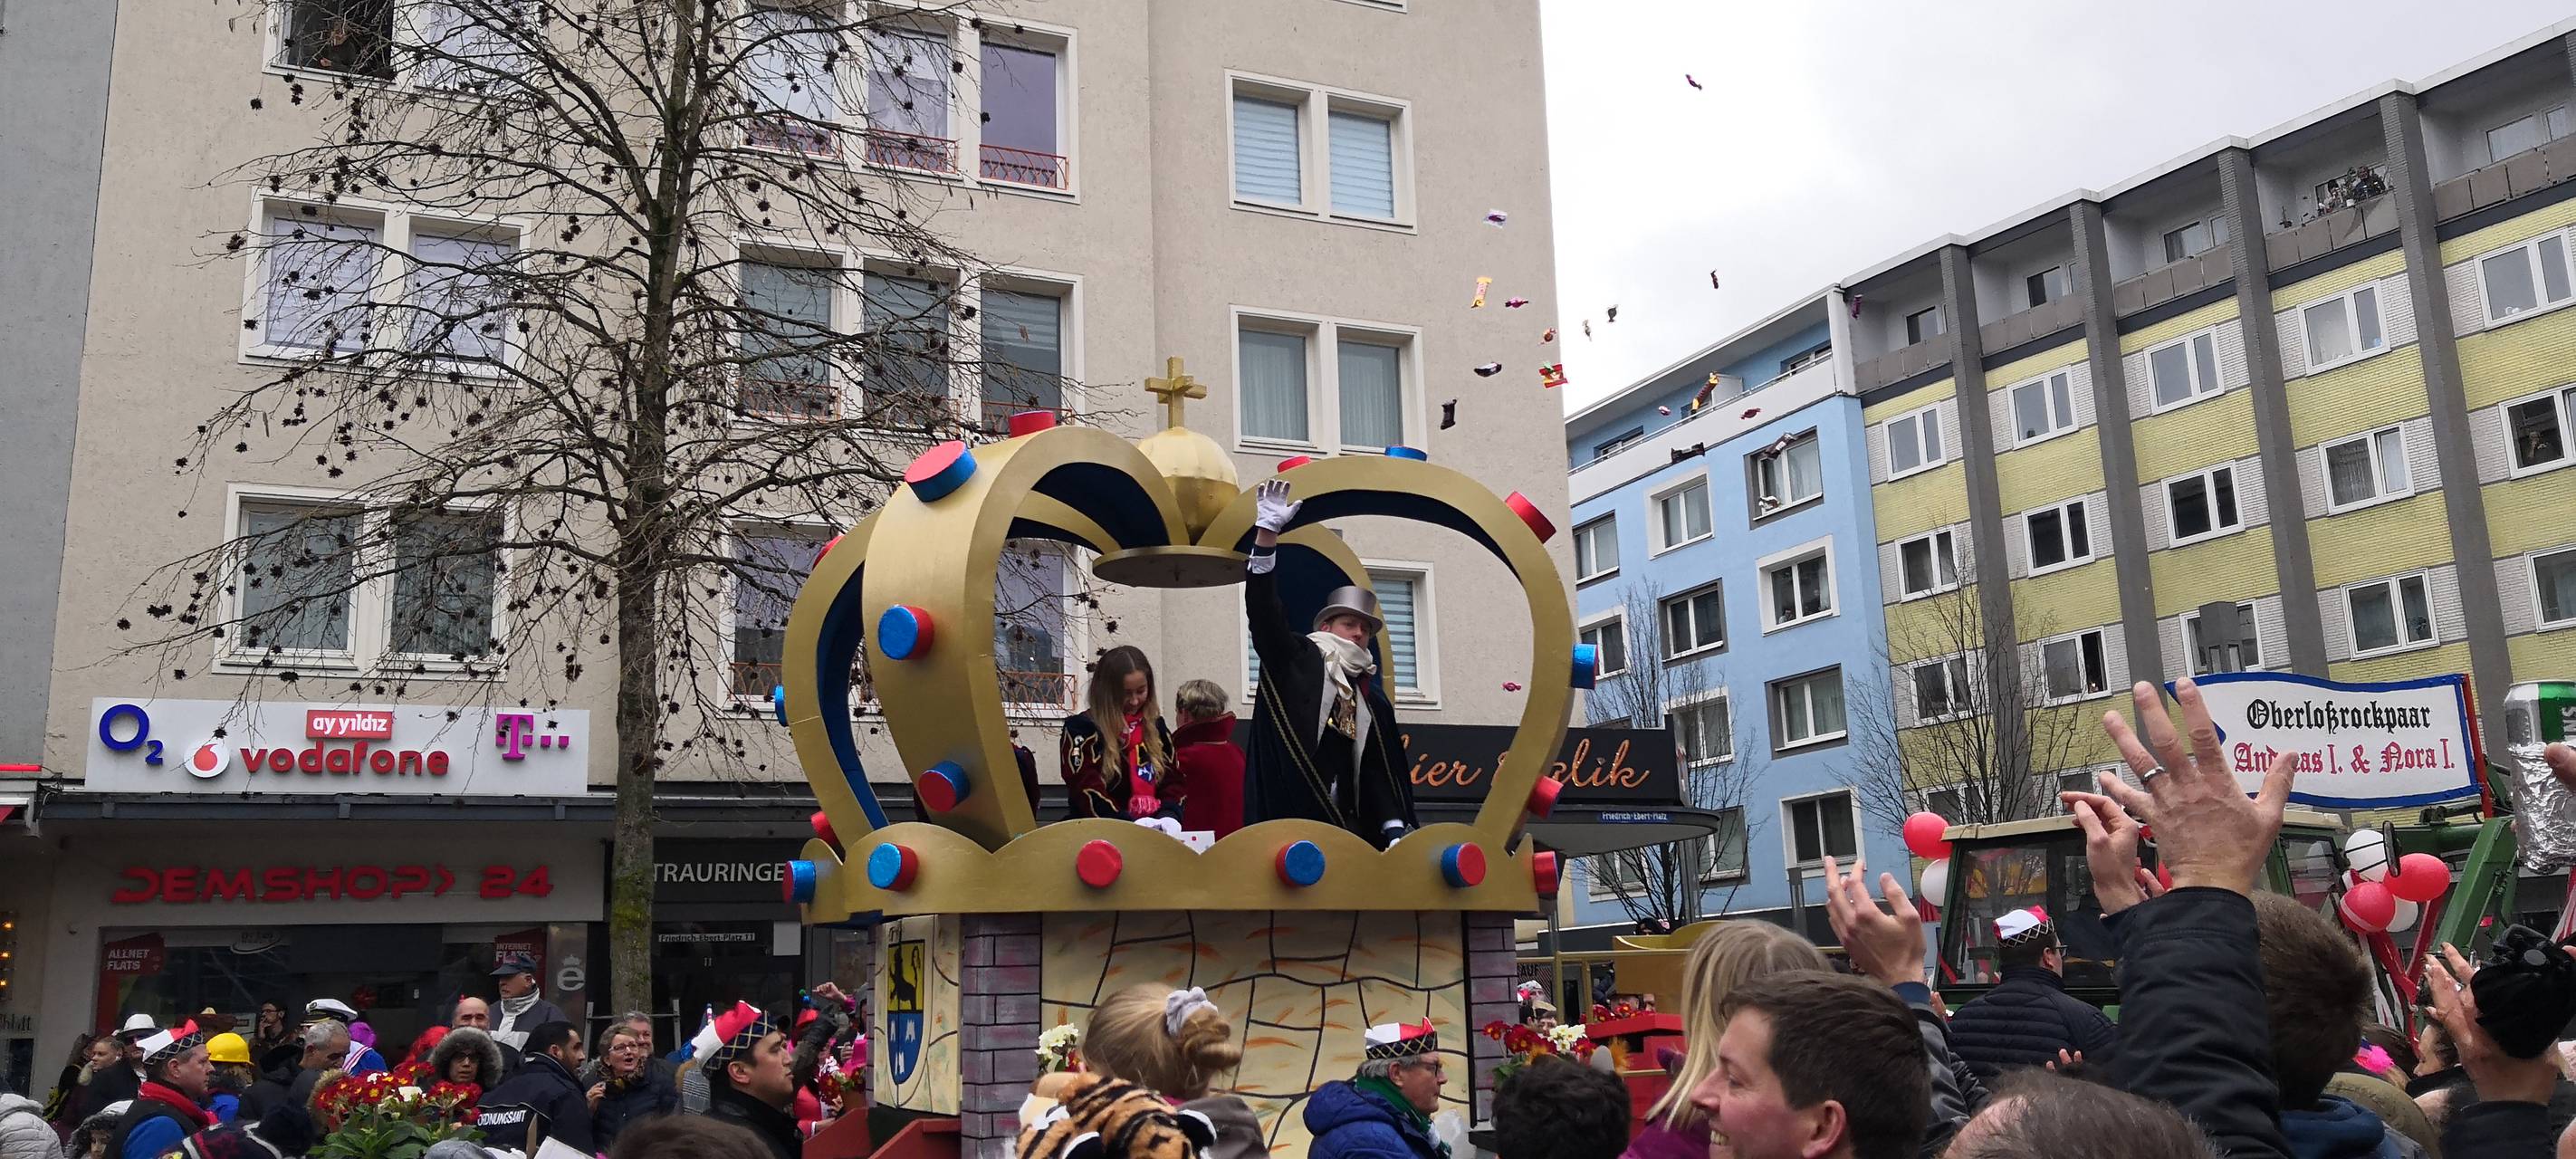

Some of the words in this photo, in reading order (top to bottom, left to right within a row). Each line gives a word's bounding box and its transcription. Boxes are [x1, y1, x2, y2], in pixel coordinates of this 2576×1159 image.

[313, 715, 336, 735] ay
[240, 741, 450, 775] vodafone
[1401, 733, 1482, 787] ier
[2234, 742, 2323, 773] Andas
[2351, 744, 2370, 773] &
[2380, 741, 2437, 774] Nora
[480, 865, 554, 899] 24
[107, 960, 141, 971] FLATS
[108, 948, 150, 959] ALLNET
